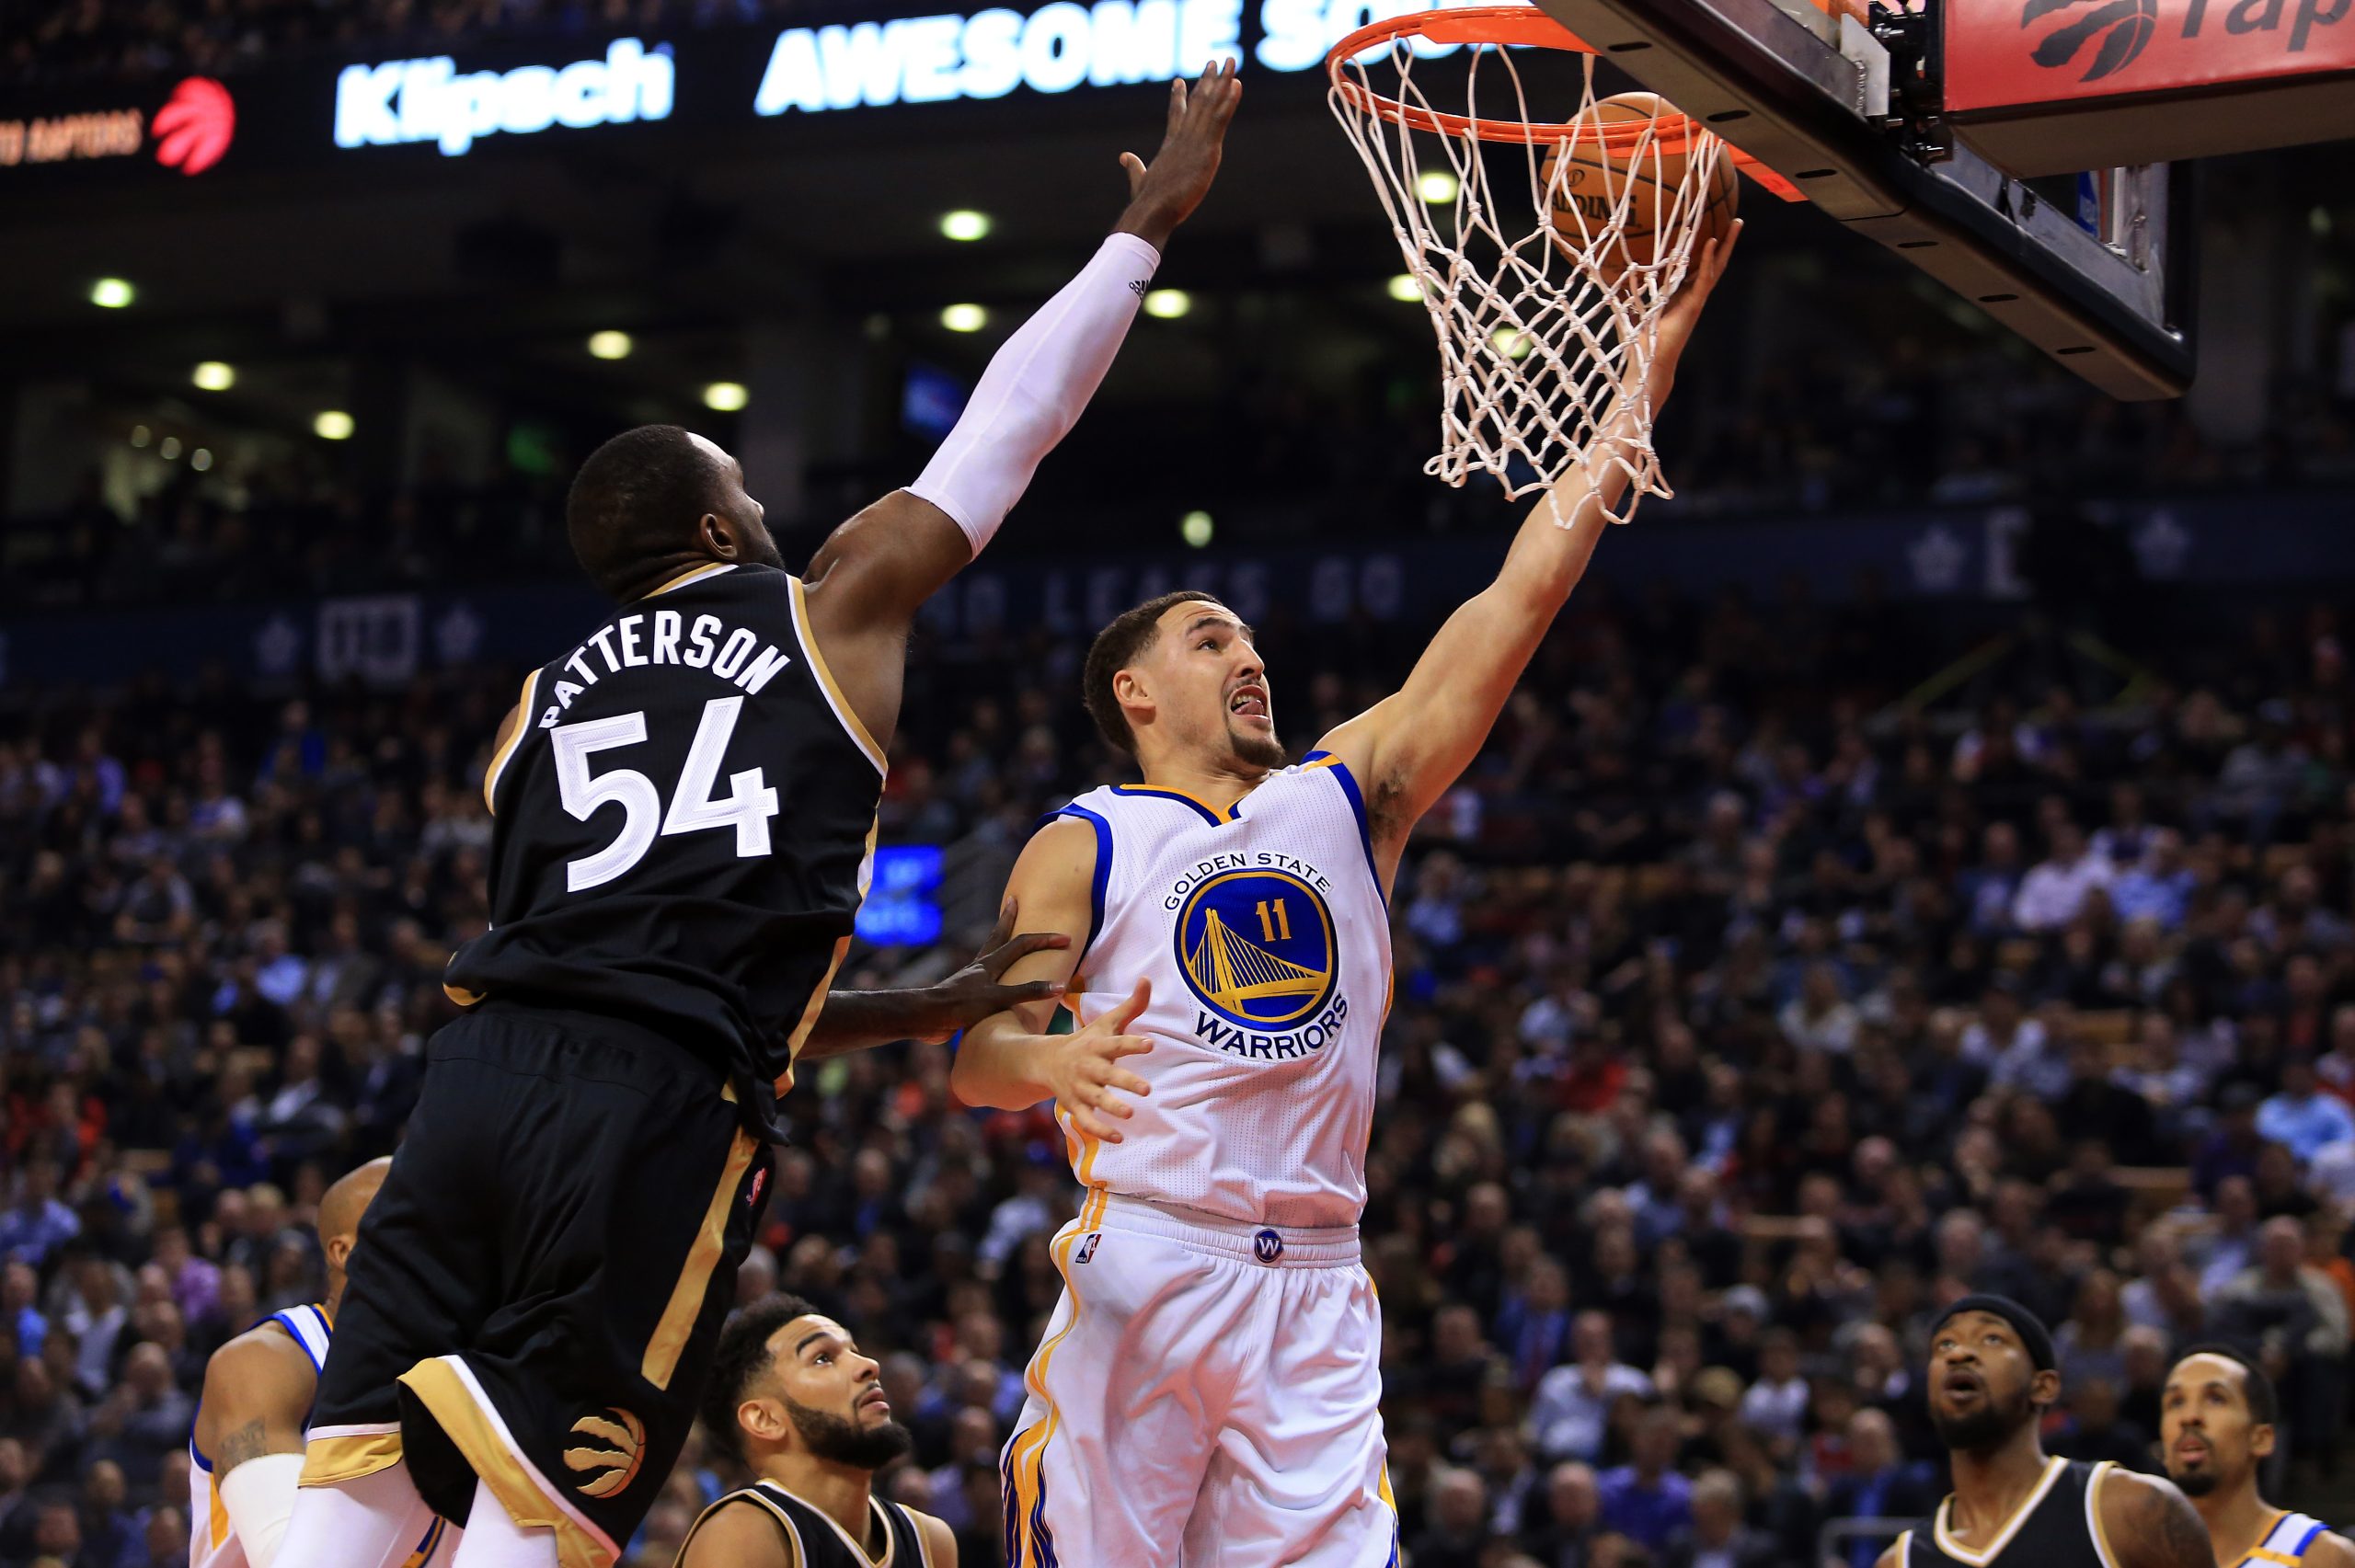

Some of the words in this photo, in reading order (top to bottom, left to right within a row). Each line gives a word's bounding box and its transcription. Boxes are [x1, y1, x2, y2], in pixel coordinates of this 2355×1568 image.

[754, 0, 1242, 115] AWESOME
[335, 38, 674, 155] Klipsch
[1543, 187, 1638, 228] ALDING
[538, 610, 791, 728] PATTERSON
[550, 695, 779, 892] 54
[1164, 853, 1246, 911] GOLDEN
[1257, 853, 1331, 893] STATE
[1255, 898, 1292, 943] 11
[1195, 993, 1349, 1060] WARRIORS
[1258, 1237, 1280, 1255] W
